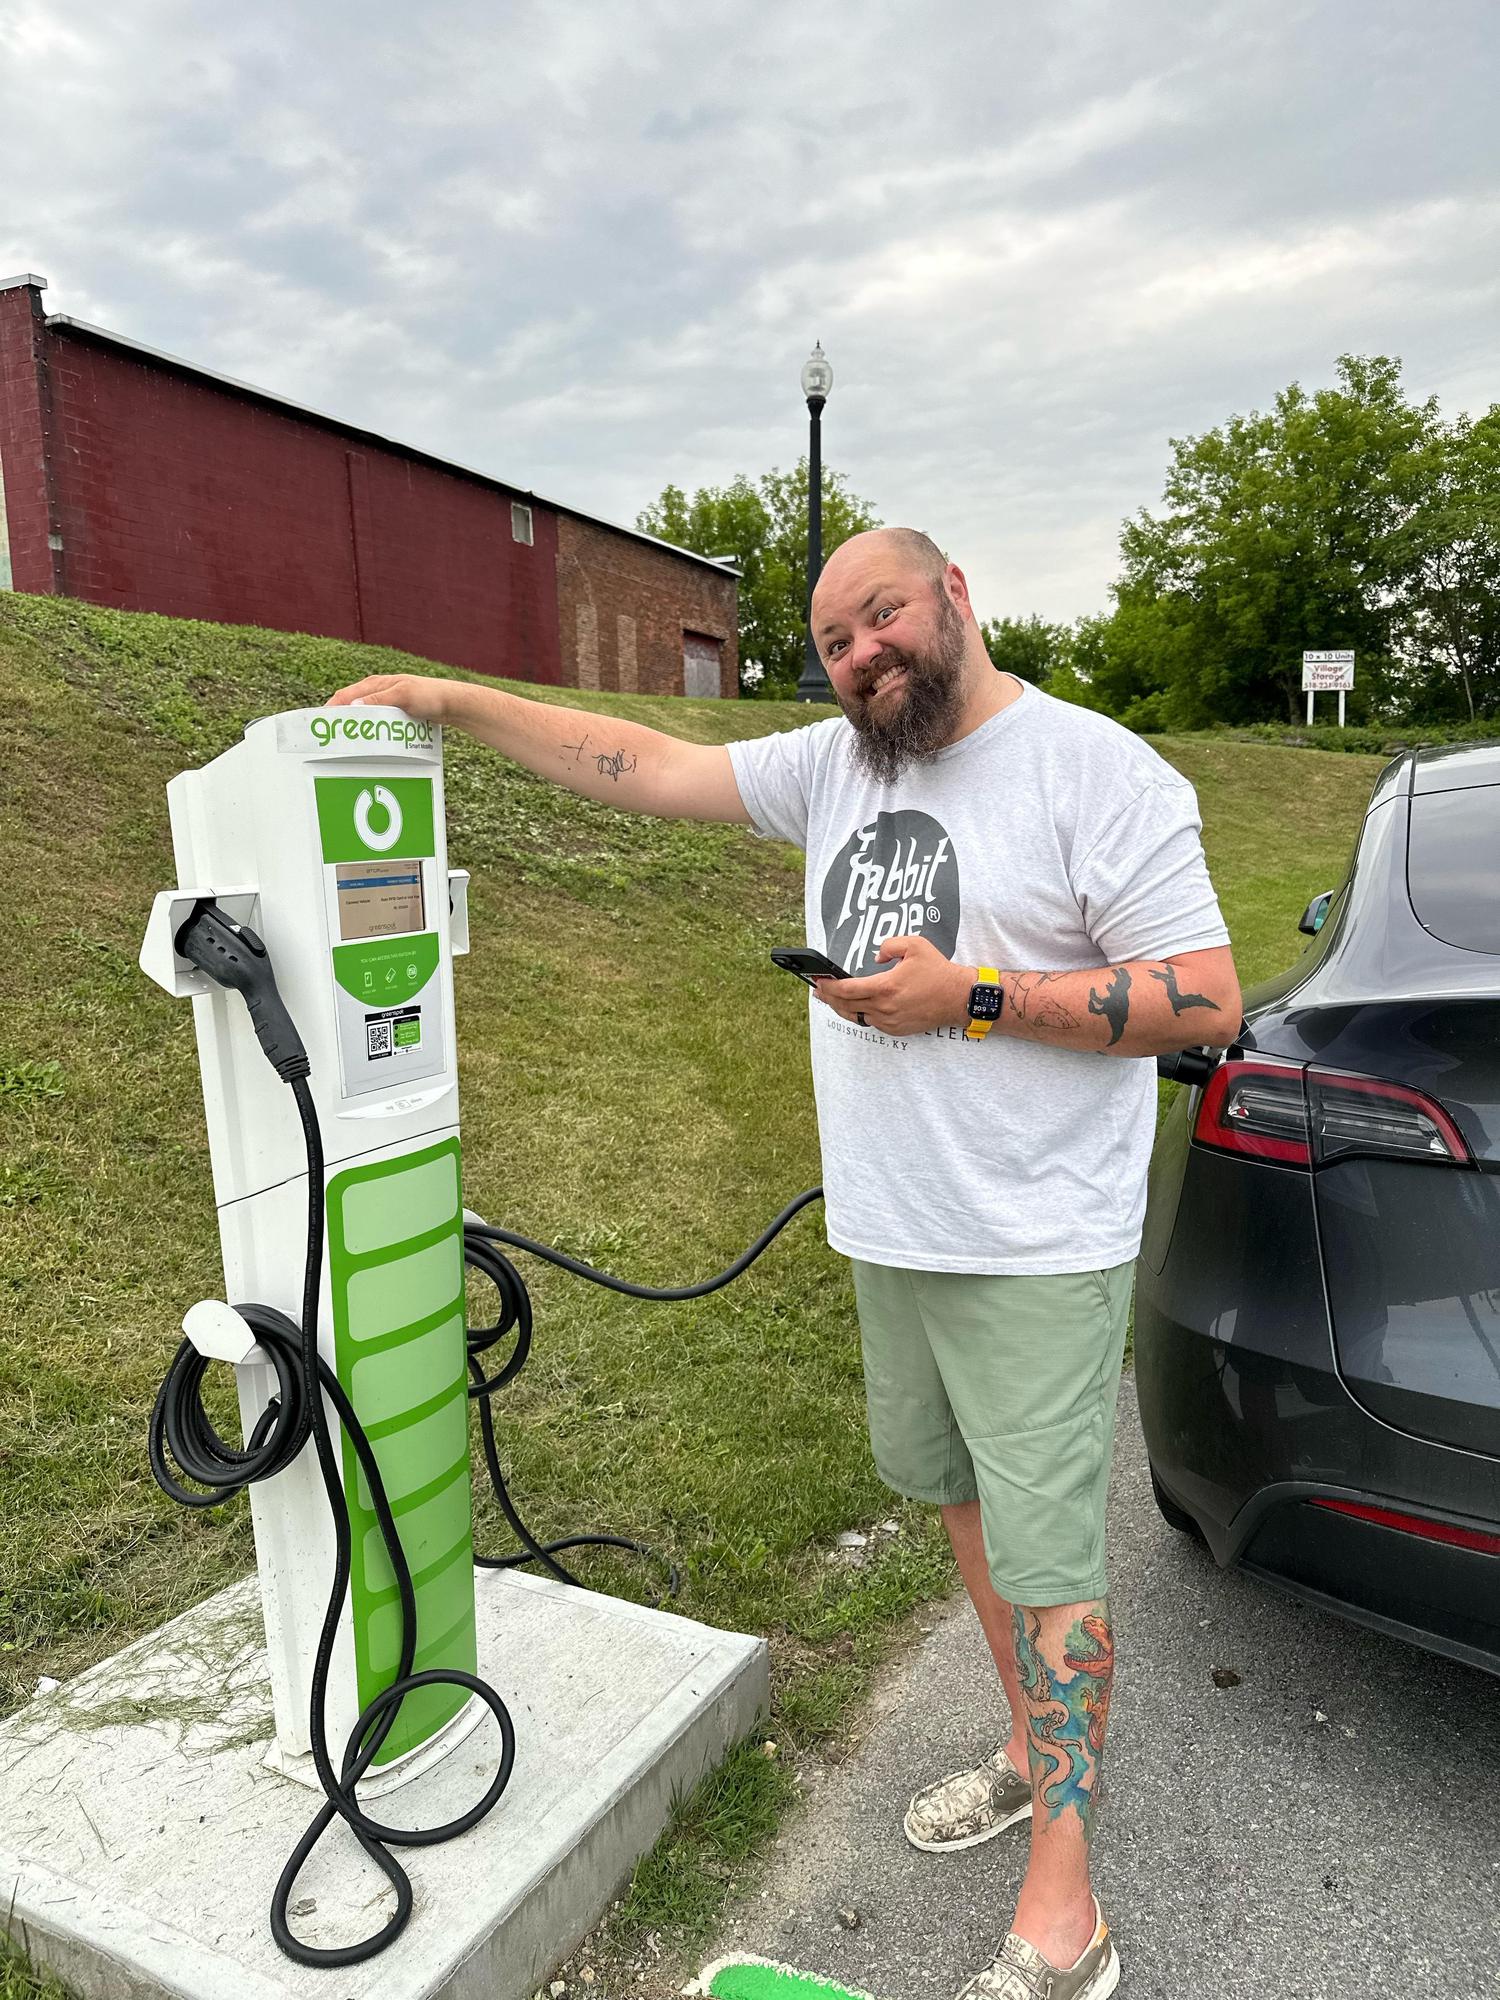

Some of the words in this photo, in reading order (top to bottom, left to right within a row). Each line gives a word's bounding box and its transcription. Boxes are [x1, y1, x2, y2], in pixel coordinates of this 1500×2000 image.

[1311, 672, 1345, 682] Storage
[1313, 664, 1344, 674] Village
[311, 717, 433, 750] greenspot
[837, 829, 950, 929] Rabbit
